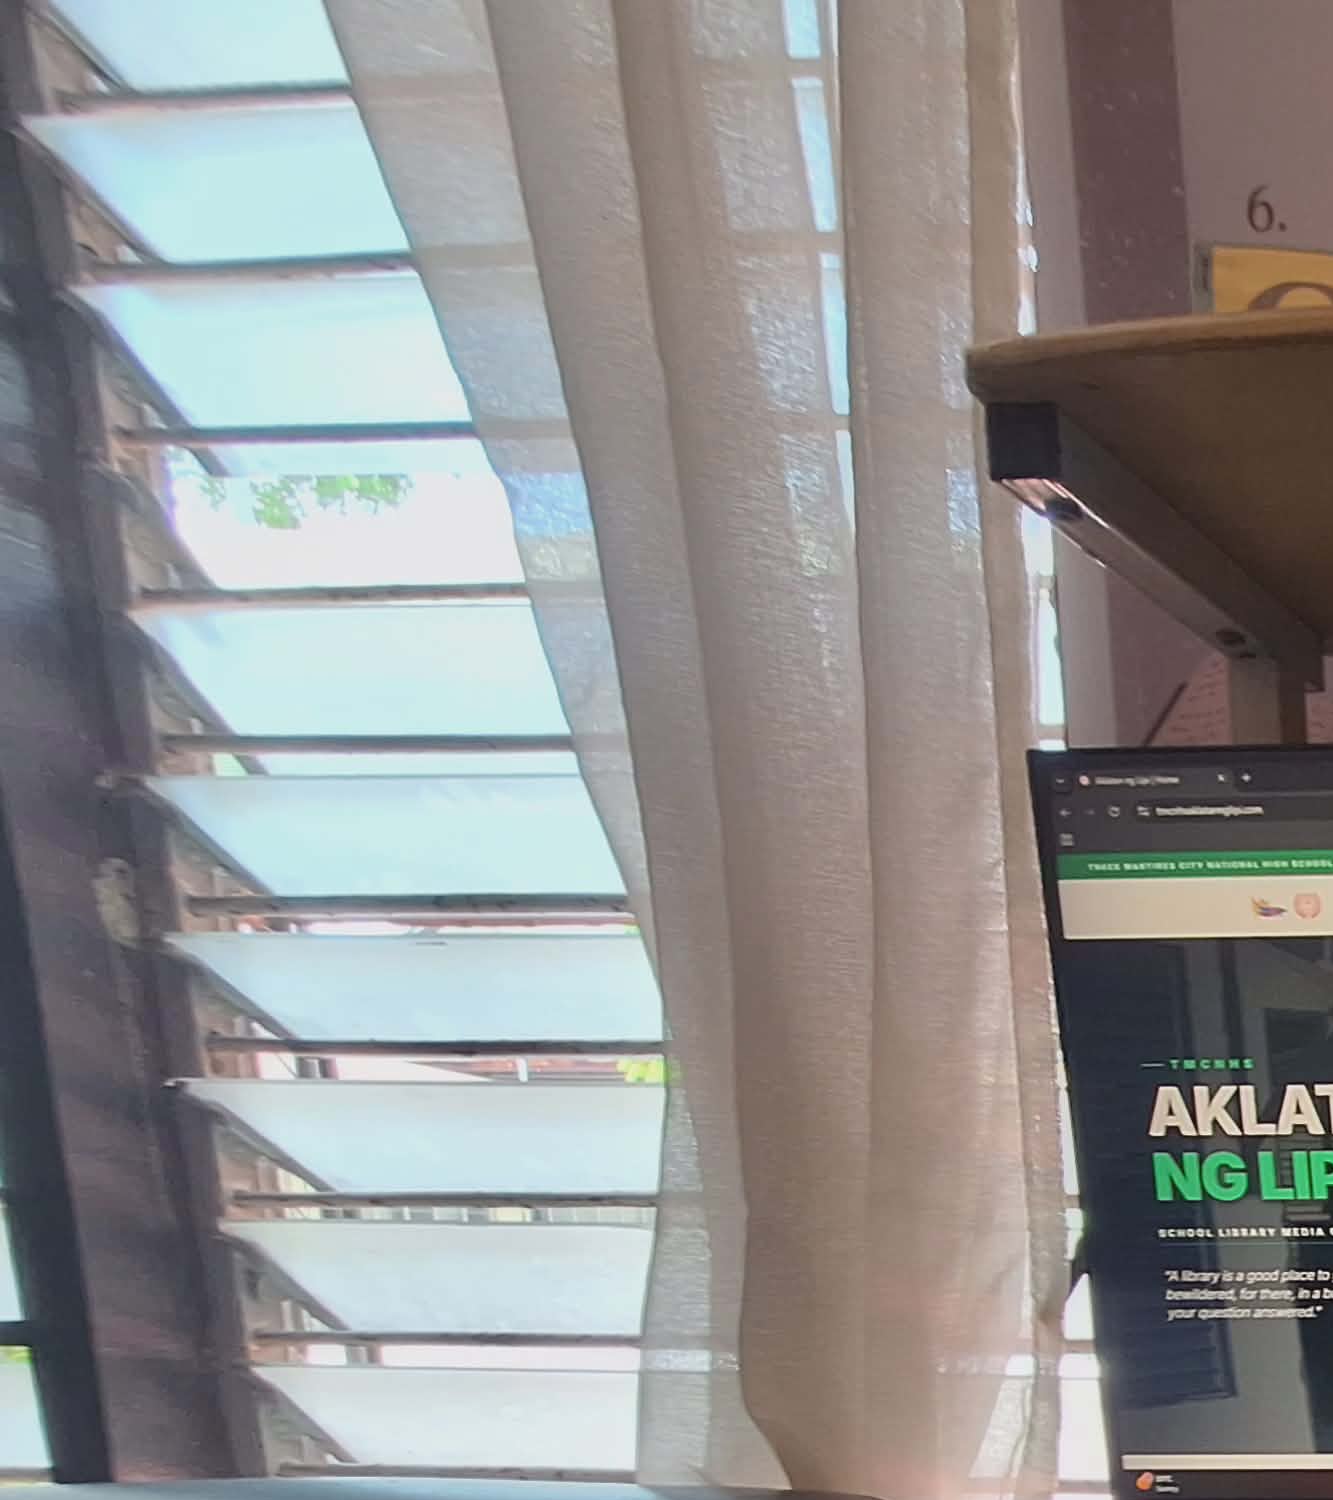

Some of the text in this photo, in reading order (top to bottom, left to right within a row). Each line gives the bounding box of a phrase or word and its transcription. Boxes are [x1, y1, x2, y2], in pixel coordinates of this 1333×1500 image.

[1248, 186, 1288, 233] 6.
[1152, 1151, 1249, 1201] NG
[1158, 1228, 1214, 1238] SCHOOL
[1218, 1228, 1276, 1238] LIBRARY
[1280, 1227, 1325, 1237] MEDIA
[1246, 1271, 1278, 1284] good
[1280, 1271, 1315, 1284] place
[1317, 1271, 1330, 1281] to
